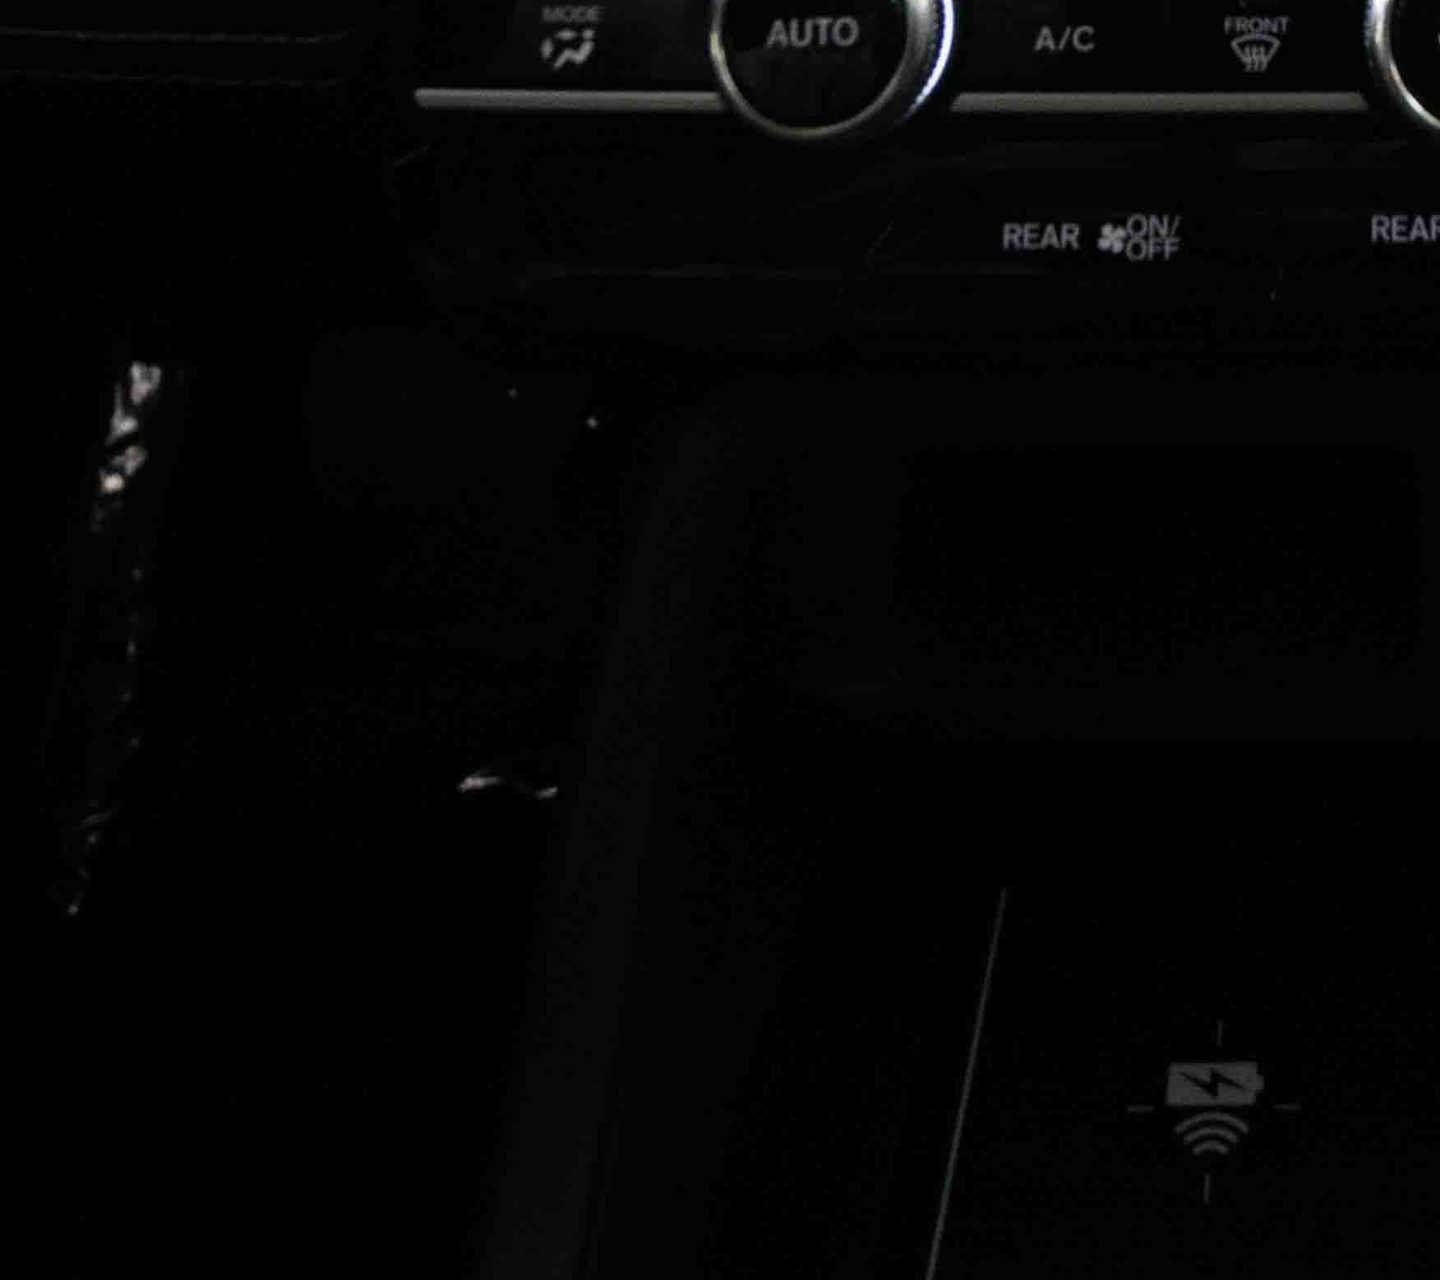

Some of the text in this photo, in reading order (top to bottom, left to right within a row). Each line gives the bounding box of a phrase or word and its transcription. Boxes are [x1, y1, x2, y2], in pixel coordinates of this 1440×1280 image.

[543, 6, 602, 22] MODE
[1224, 16, 1289, 34] FRONT
[767, 18, 858, 47] AUTO
[1035, 26, 1095, 51] A/C
[1002, 224, 1079, 250] REAR
[1127, 215, 1180, 239] ON/
[1126, 238, 1179, 261] OFF
